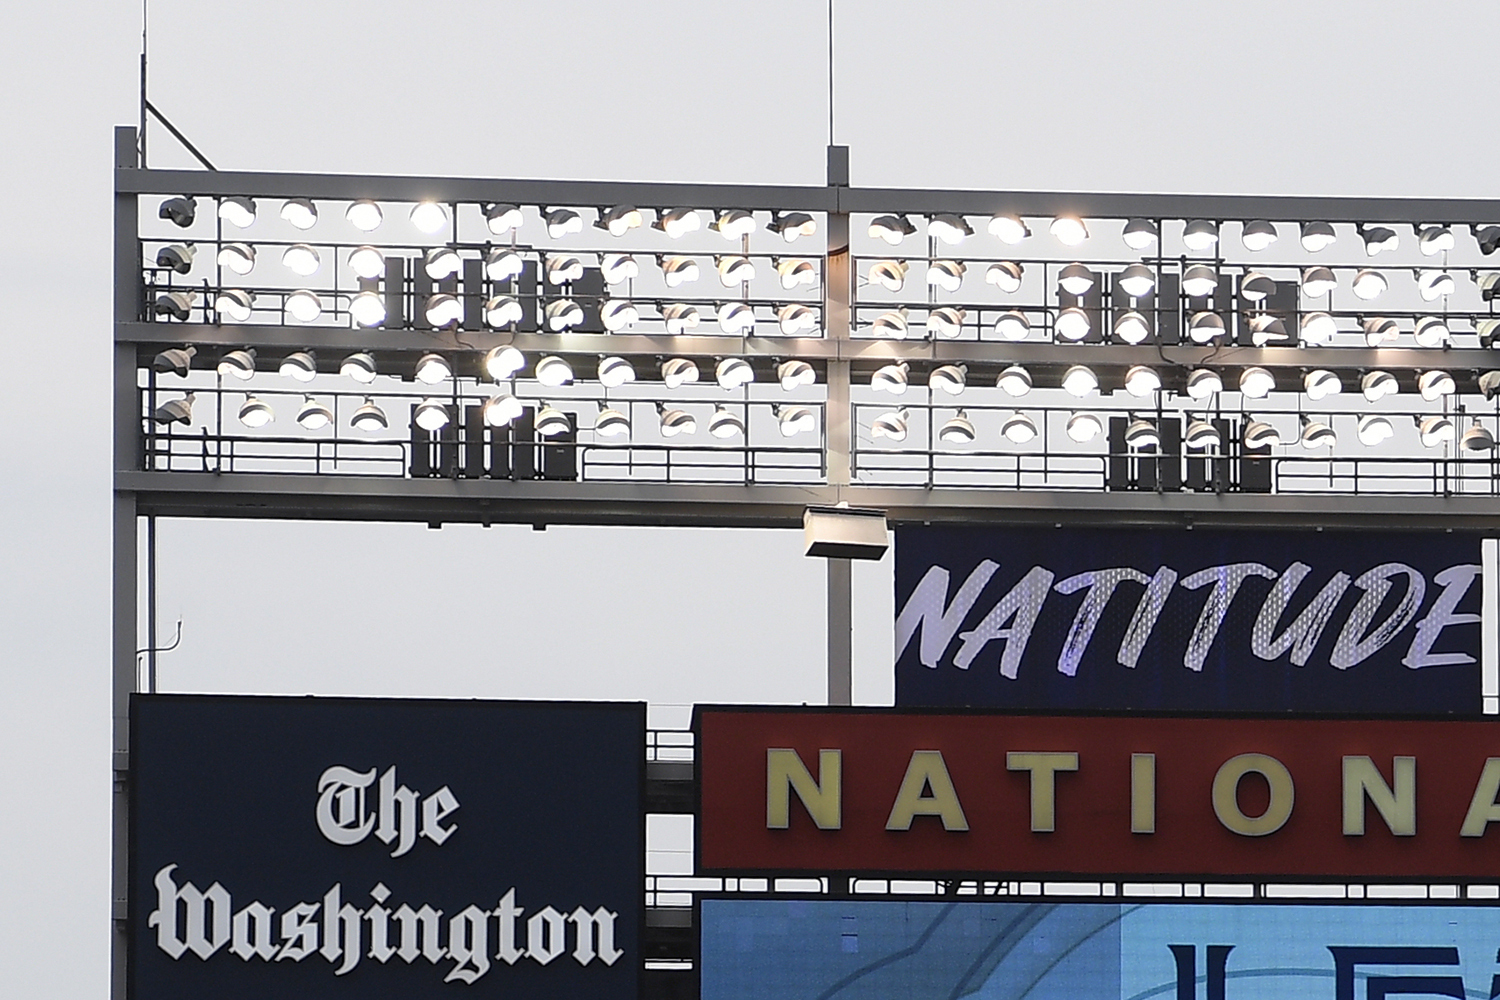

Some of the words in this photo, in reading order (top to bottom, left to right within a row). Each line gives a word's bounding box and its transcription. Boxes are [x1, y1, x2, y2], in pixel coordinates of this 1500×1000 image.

[895, 559, 1482, 679] NATITUDE
[316, 764, 460, 857] The
[149, 863, 624, 985] Washington
